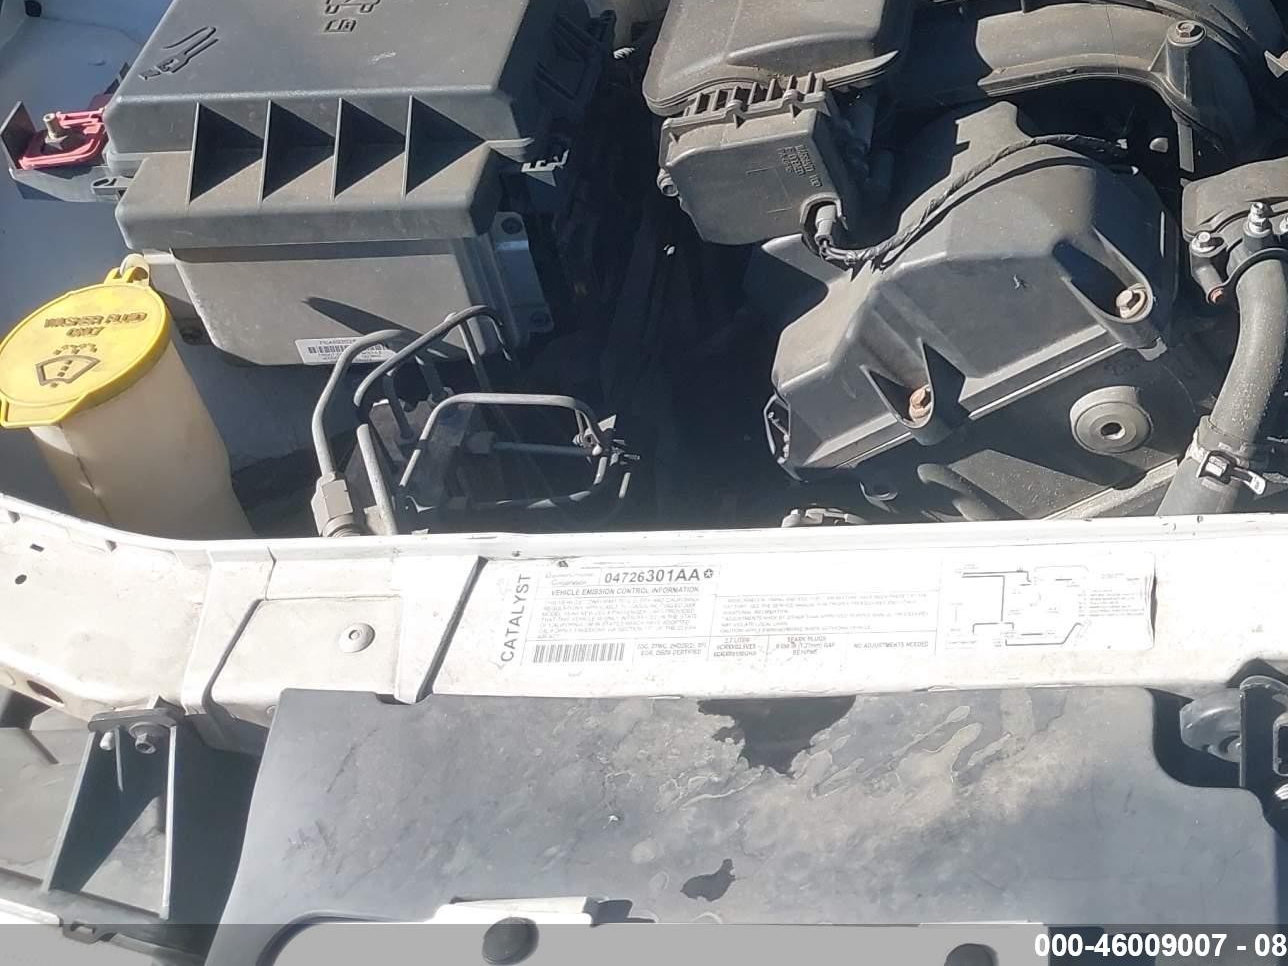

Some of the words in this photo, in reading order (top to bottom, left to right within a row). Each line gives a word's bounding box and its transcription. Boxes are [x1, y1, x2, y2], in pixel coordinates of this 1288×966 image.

[604, 568, 701, 583] 04726301AA
[651, 586, 700, 594] INFORMATION
[499, 574, 531, 663] CATALYST
